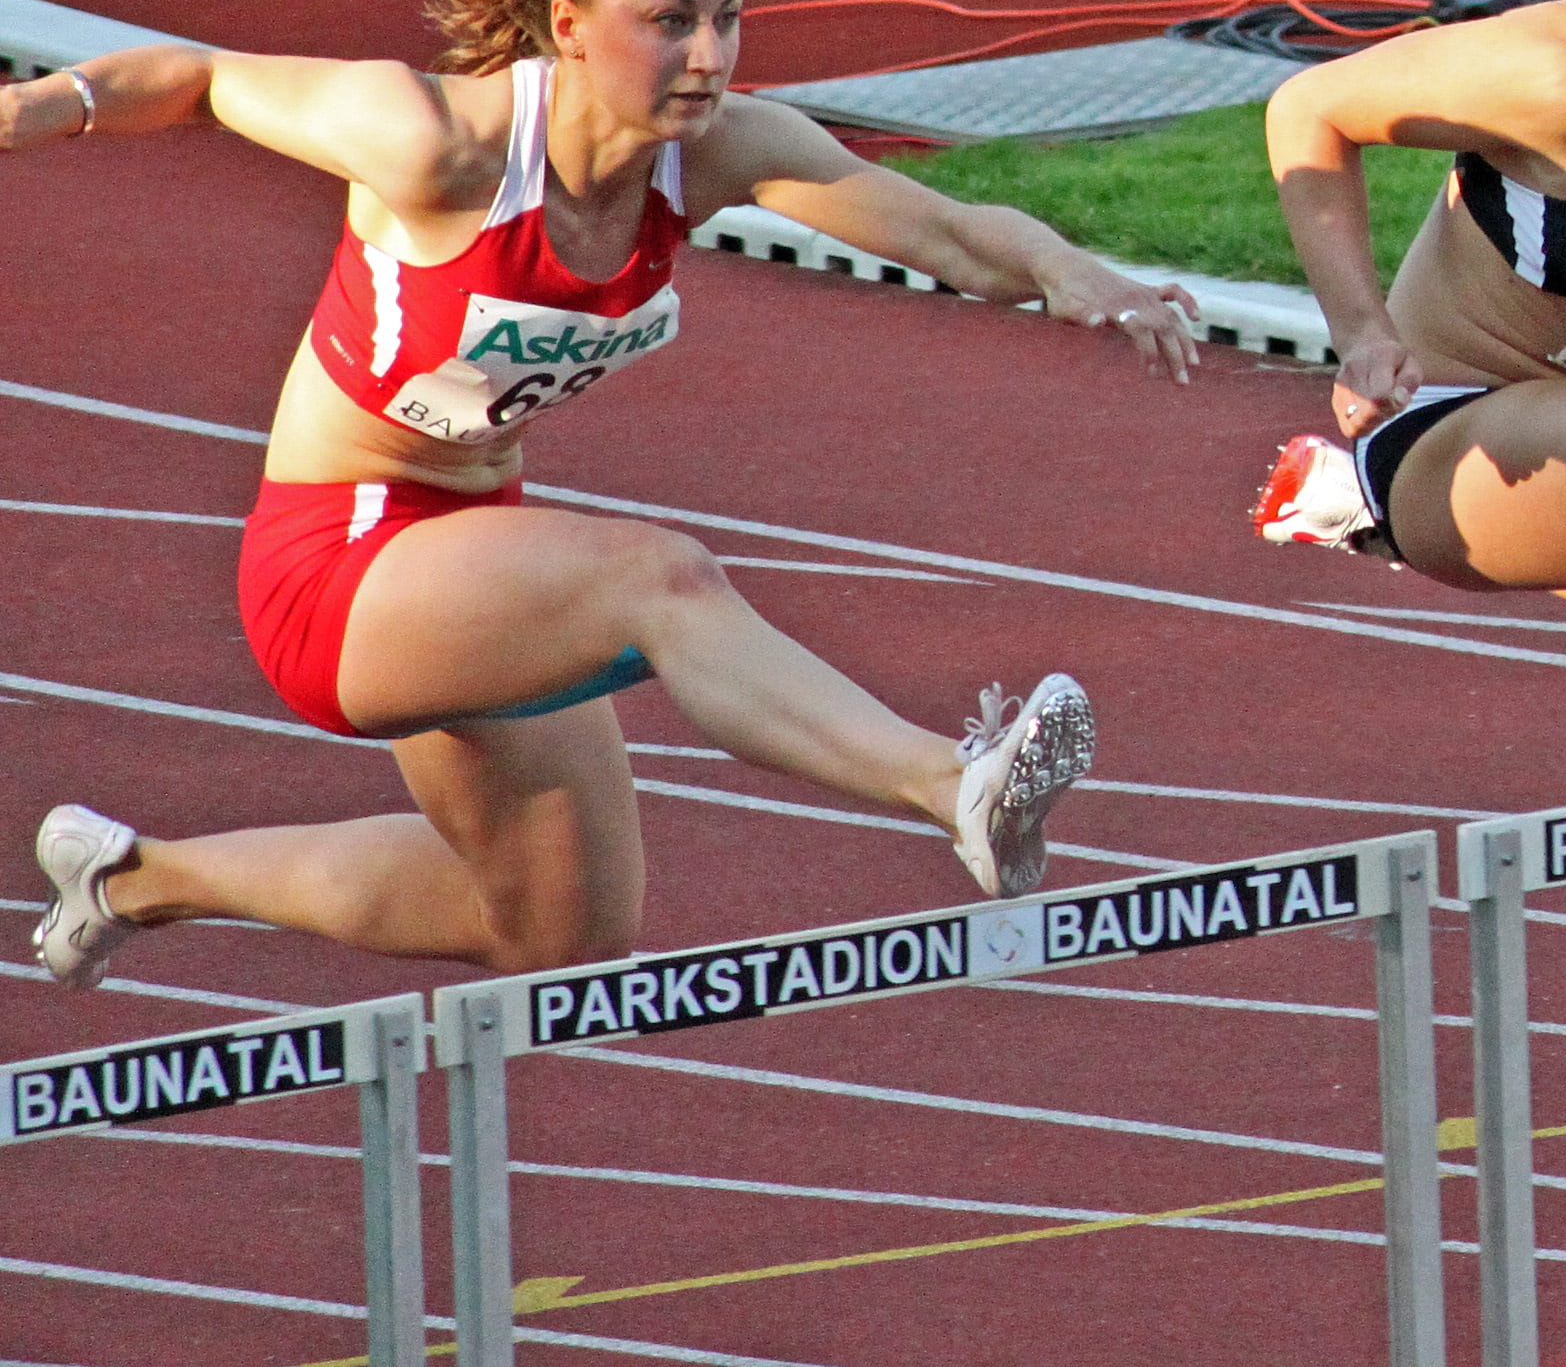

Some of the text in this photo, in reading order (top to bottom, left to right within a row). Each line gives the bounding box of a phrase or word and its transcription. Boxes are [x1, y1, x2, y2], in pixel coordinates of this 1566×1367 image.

[466, 313, 669, 365] Askina
[537, 863, 1355, 1042] PARKSTADION BAUNATAL
[16, 1029, 342, 1131] BAUNATAL
